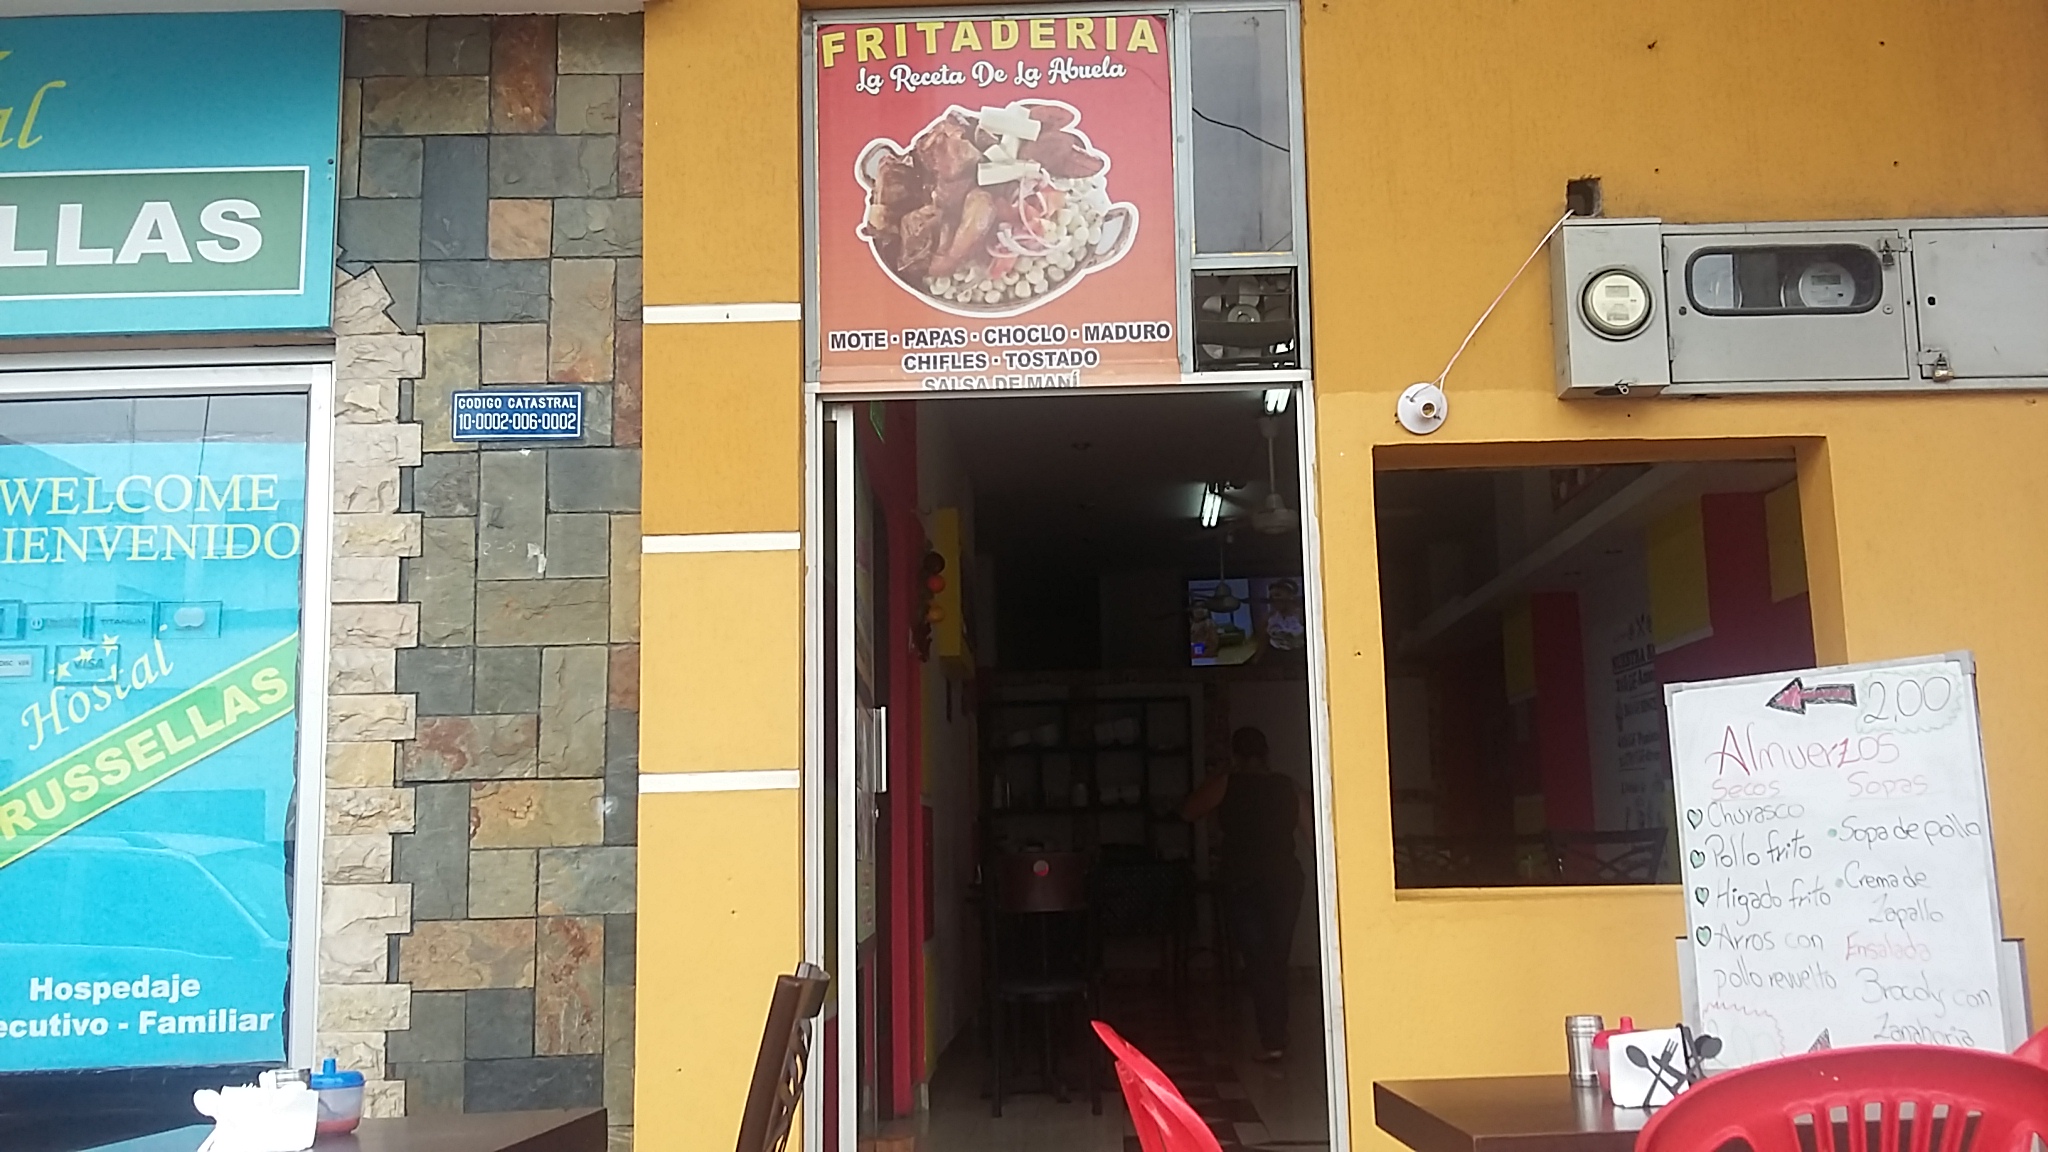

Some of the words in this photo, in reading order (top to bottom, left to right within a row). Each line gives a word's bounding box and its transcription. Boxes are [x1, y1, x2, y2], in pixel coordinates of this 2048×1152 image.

[821, 17, 1158, 68] FRITADERIA
[856, 67, 884, 94] La
[889, 63, 966, 93] Receta
[971, 60, 1008, 88] De
[1013, 60, 1042, 88] La
[1047, 55, 1127, 85] Abuela
[0, 199, 262, 266] LLAS
[831, 332, 886, 349] MOTE
[904, 329, 966, 347] PAPAS
[984, 327, 1066, 344] CHOCLO
[1084, 323, 1171, 342] MADURO
[903, 353, 987, 371] CHIFLES
[1005, 350, 1098, 368] TOSTADO
[924, 377, 987, 390] SALSA
[995, 376, 1020, 389] DE
[458, 397, 502, 409] CODIGO
[508, 397, 577, 409] CATASTRAL
[0, 474, 280, 516] WELCOME
[0, 522, 300, 563] IENVENIDO
[20, 624, 175, 751] Hostal
[0, 666, 290, 841] RUSSELLAS
[1704, 831, 1760, 868] Pollo
[1766, 828, 1812, 864] frito
[1839, 815, 1889, 850] Sopa
[1893, 816, 1919, 839] de
[1923, 812, 1982, 846] pollo
[1844, 860, 1899, 889] Crema
[1902, 865, 1930, 889] de
[1716, 876, 1782, 926] Higado
[1788, 875, 1831, 909] frito
[1784, 933, 1824, 951] con
[29, 974, 201, 1005] Hospedaje
[1713, 954, 1763, 998] pollo
[138, 1008, 275, 1035] Familiar
